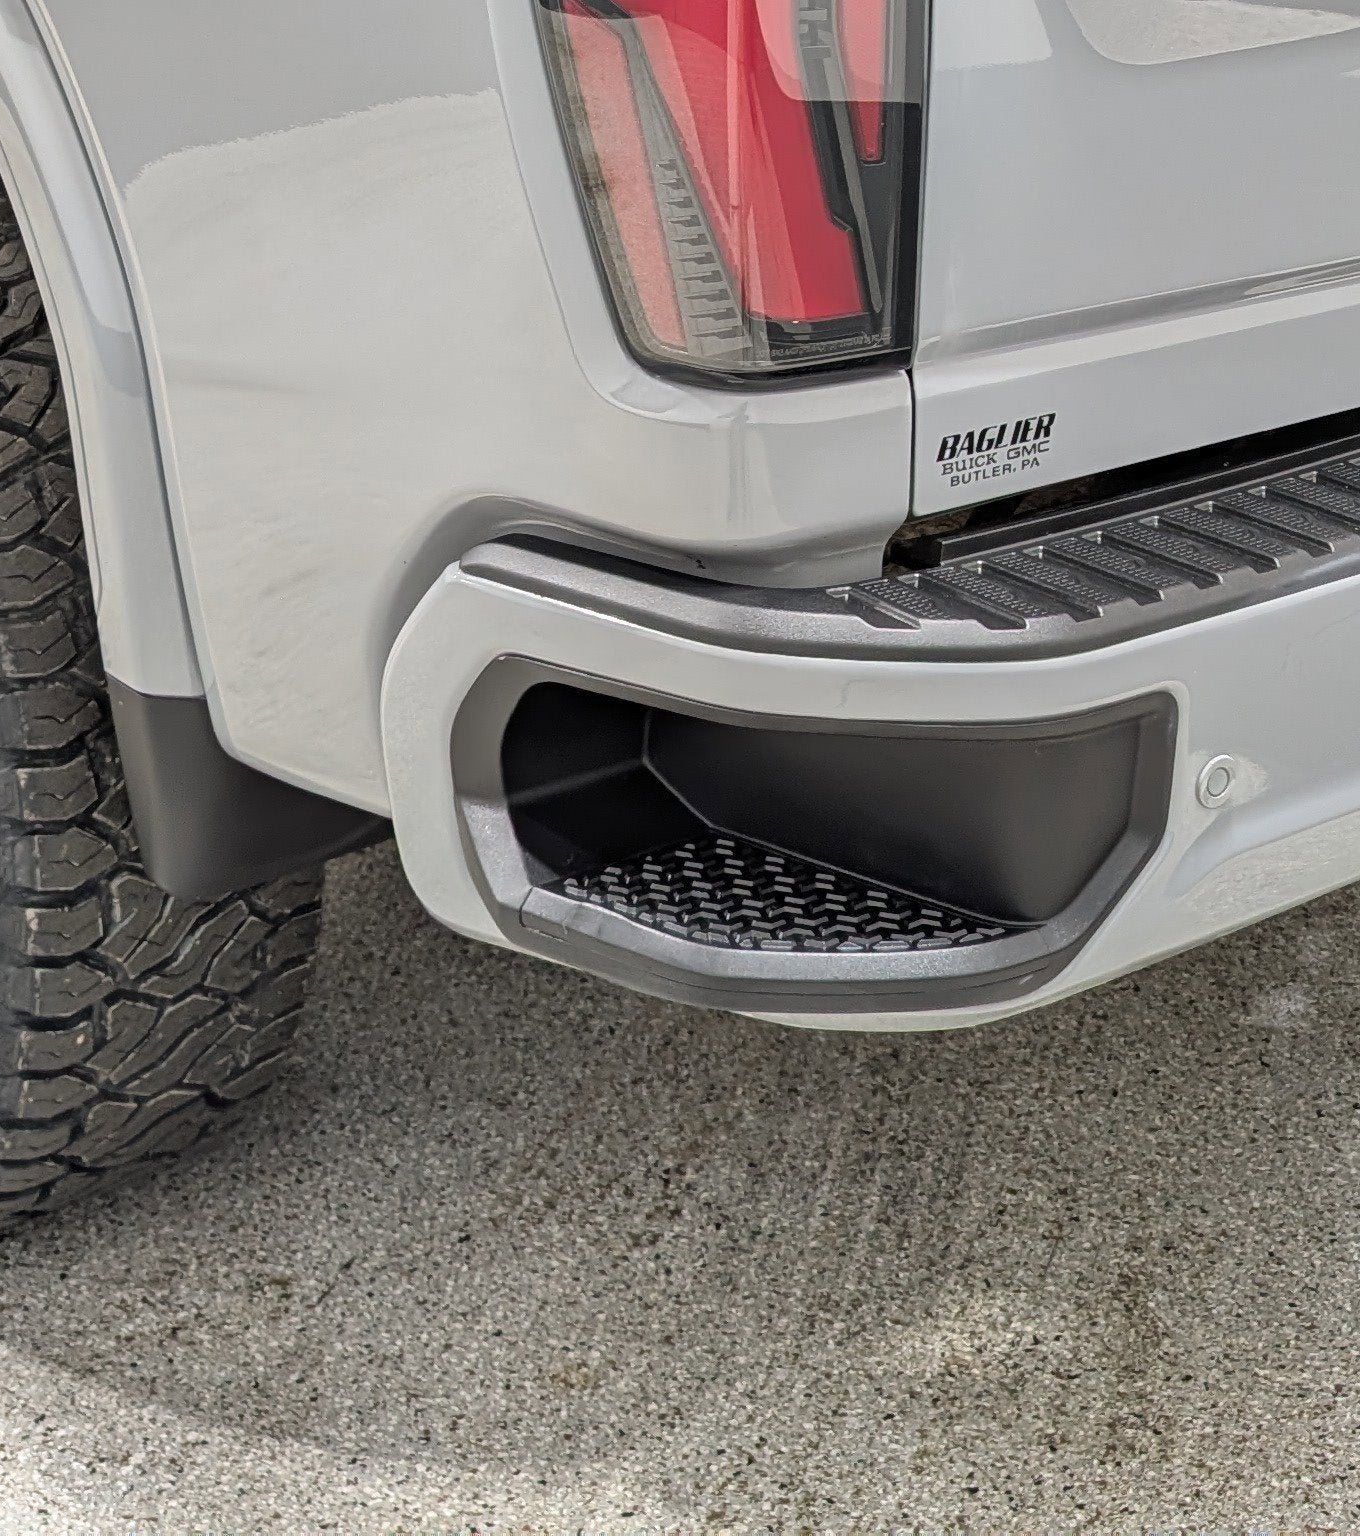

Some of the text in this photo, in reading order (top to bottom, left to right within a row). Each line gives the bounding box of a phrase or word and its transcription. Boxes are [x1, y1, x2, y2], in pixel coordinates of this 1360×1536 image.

[936, 412, 1057, 463] BAGLIER
[941, 439, 1051, 477] BUICK GMC
[950, 456, 1041, 488] BUTLER, PA
